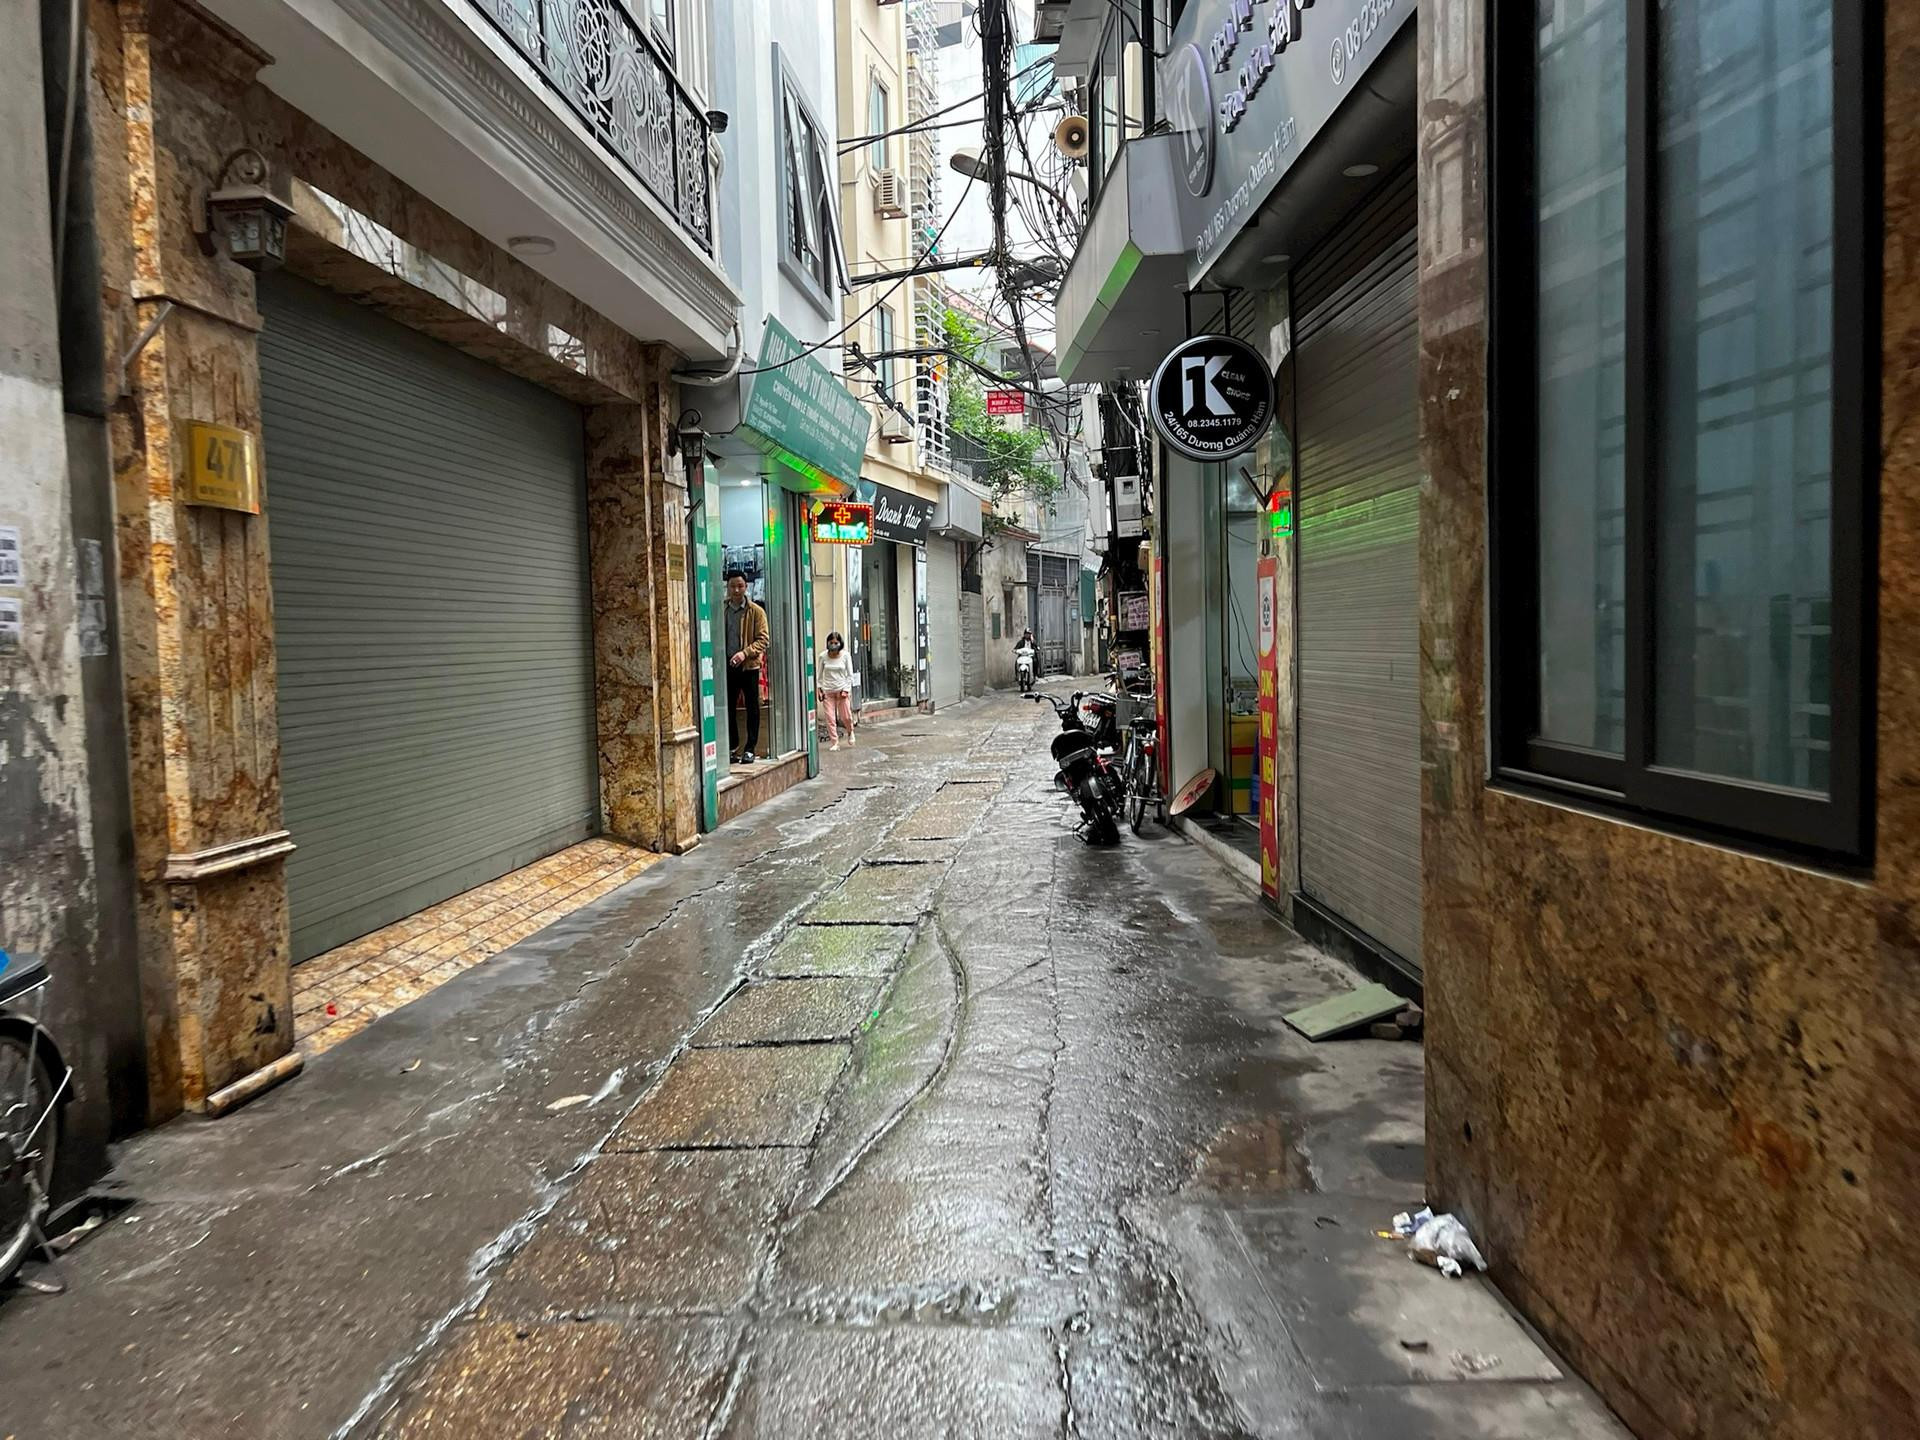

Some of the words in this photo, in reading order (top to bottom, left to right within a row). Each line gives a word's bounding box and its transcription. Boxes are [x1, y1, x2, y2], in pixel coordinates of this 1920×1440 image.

[1345, 17, 1361, 60] 08
[1164, 411, 1189, 440] 24/165
[1188, 434, 1224, 451] Dương
[1225, 424, 1257, 447] Quảng
[1251, 401, 1267, 424] Hàm
[1187, 418, 1242, 428] 08.2345.1179
[206, 437, 240, 482] 47
[875, 496, 903, 525] Doanh
[903, 504, 923, 530] Hair
